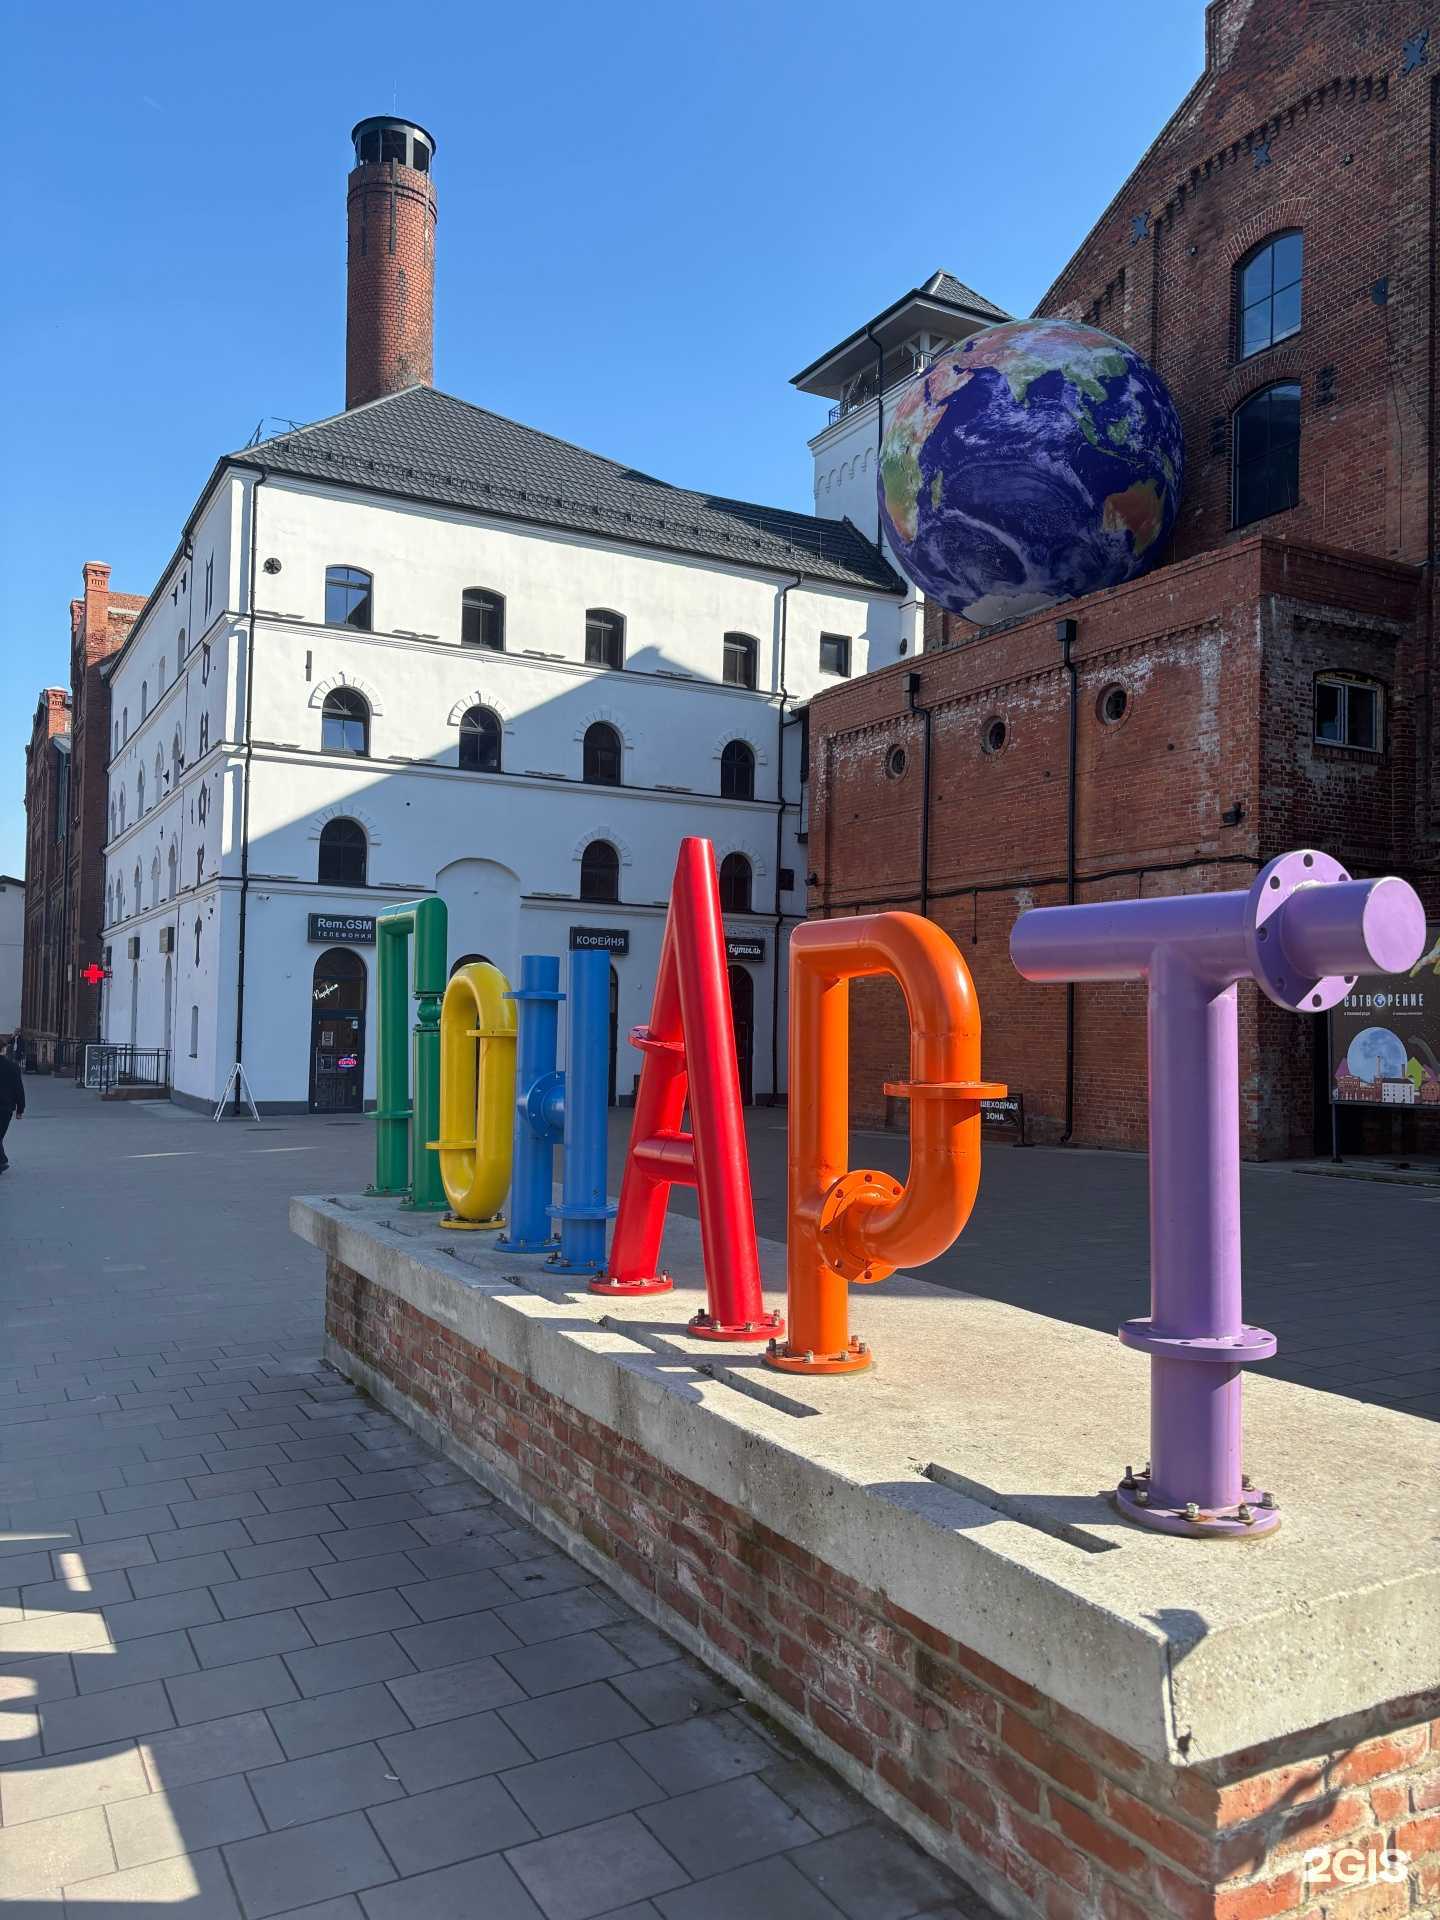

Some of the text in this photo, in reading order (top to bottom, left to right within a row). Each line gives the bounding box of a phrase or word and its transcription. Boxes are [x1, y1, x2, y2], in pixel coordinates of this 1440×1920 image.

[317, 918, 372, 930] Rem.GSM
[318, 931, 372, 940] ТЕЛЕФОНИЯ
[576, 935, 625, 946] КОФЕЙНЯ
[728, 943, 761, 955] Бутыль
[980, 1100, 1019, 1110] ШЕХОДНАЯ
[986, 1112, 1005, 1120] ЗОНА
